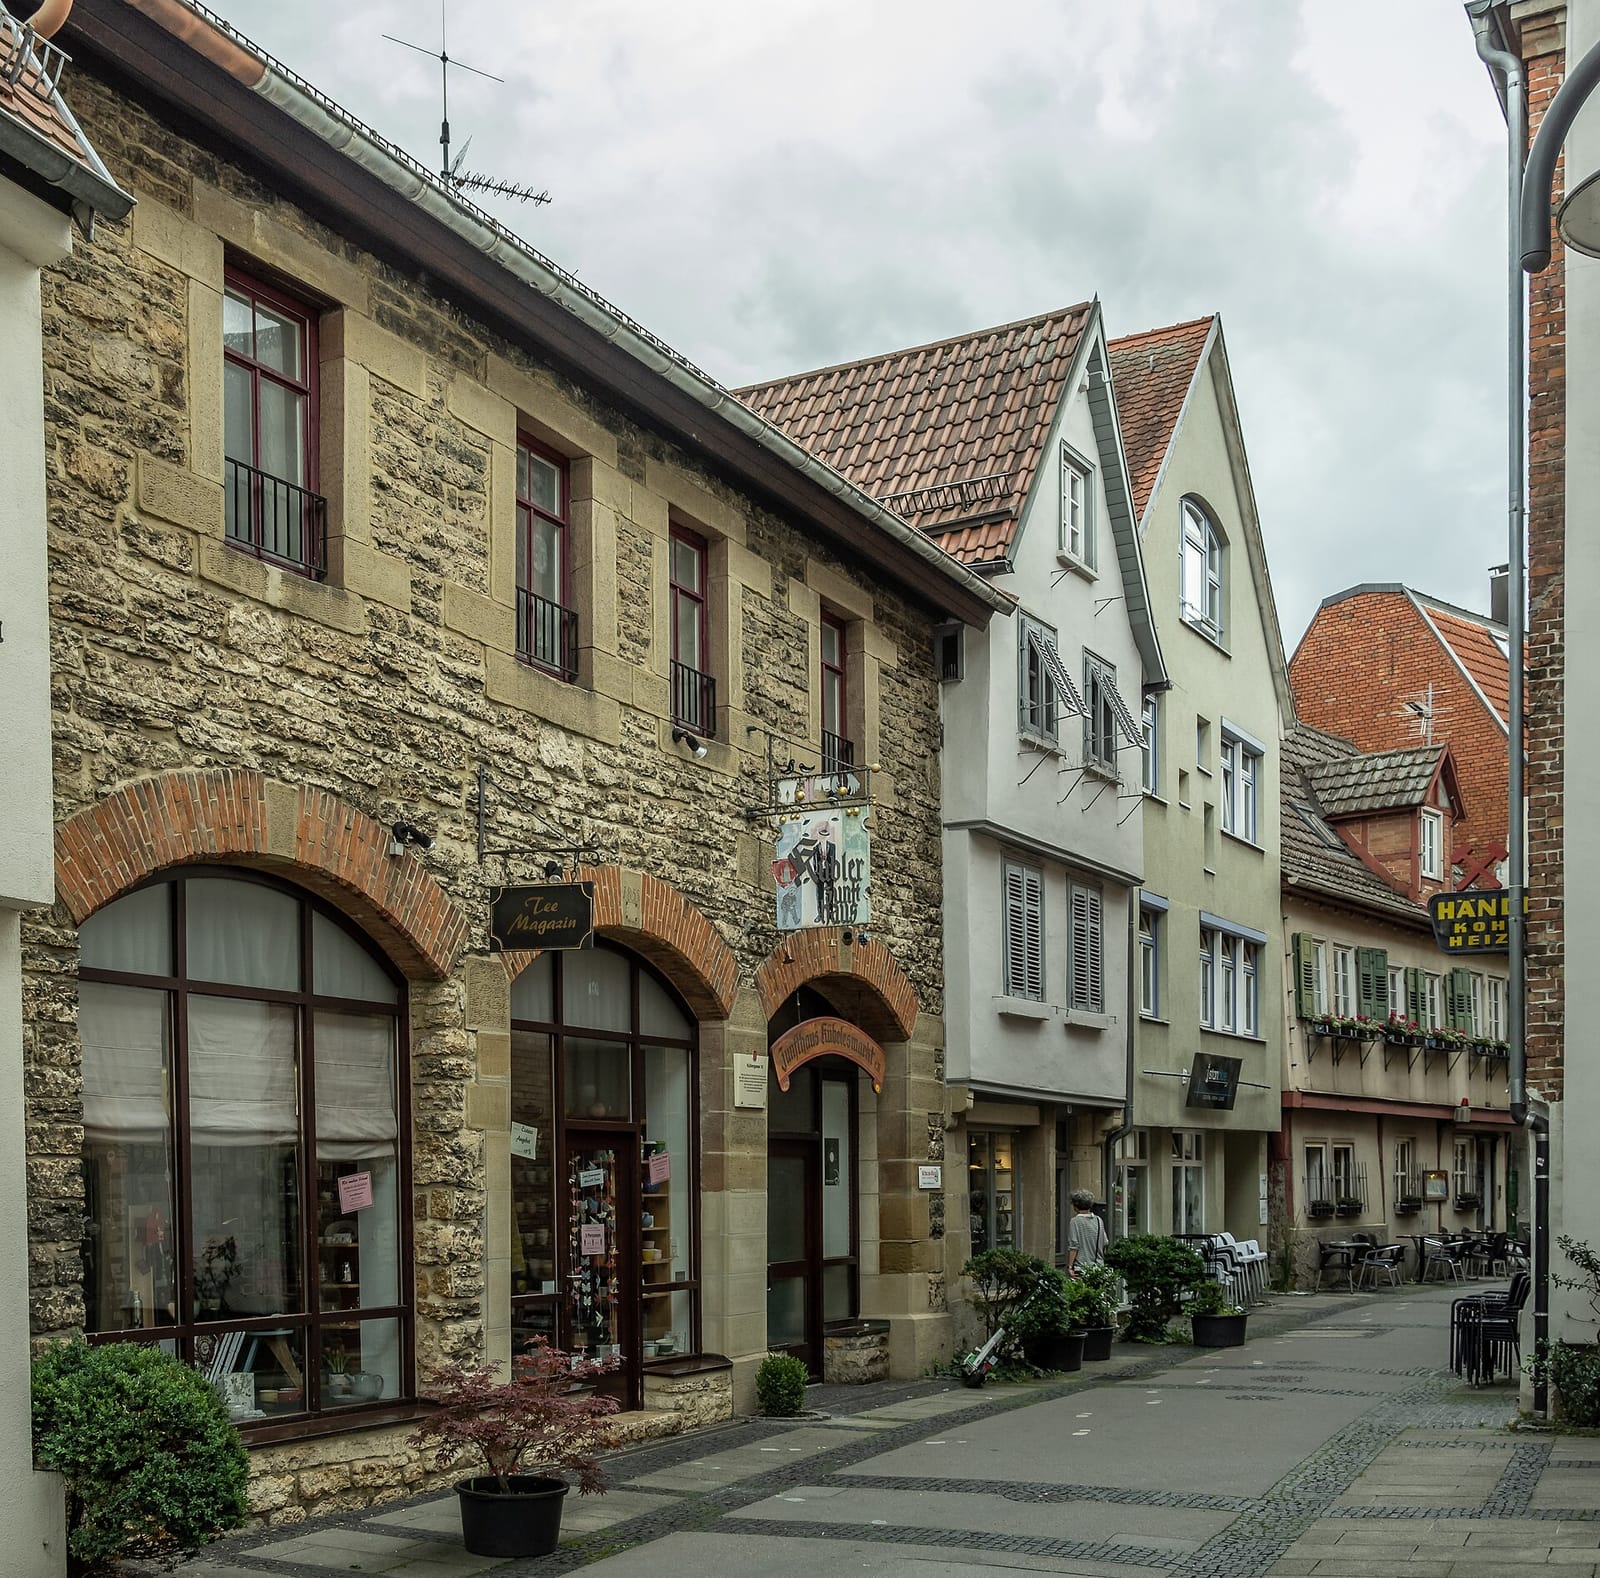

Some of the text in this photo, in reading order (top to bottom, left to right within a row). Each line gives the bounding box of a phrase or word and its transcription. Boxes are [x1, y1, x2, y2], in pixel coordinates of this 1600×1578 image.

[524, 896, 560, 915] Tee
[507, 914, 577, 936] Magazin
[1449, 934, 1508, 947] HEIZ
